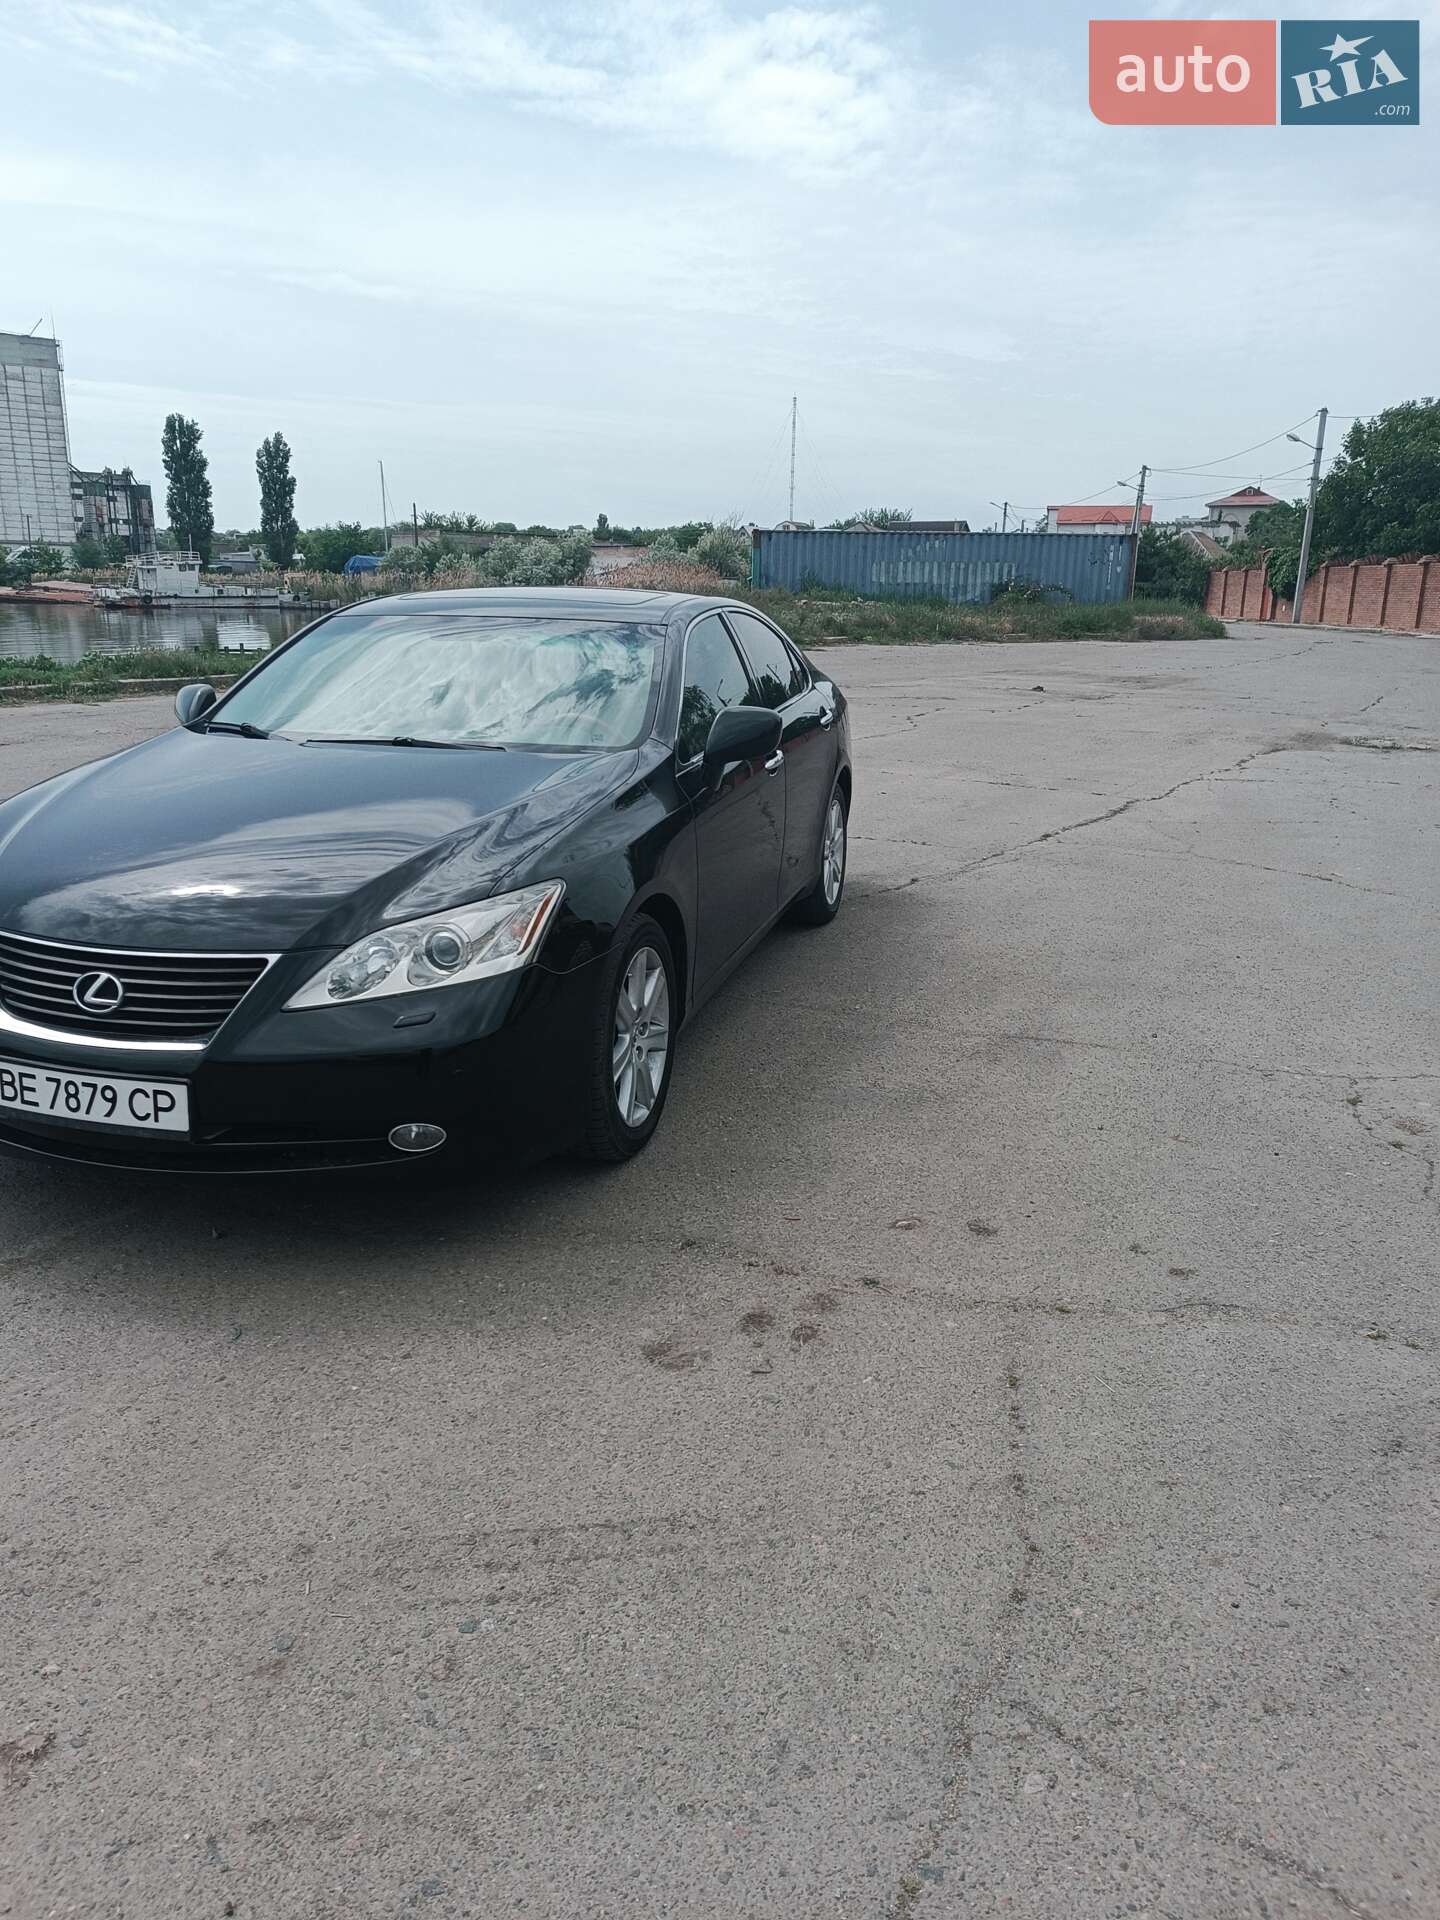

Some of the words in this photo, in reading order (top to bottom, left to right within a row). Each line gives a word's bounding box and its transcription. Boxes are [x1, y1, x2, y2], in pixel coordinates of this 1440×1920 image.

[0, 1068, 40, 1108] BE
[45, 1076, 118, 1118] 7879
[128, 1087, 176, 1123] CP
